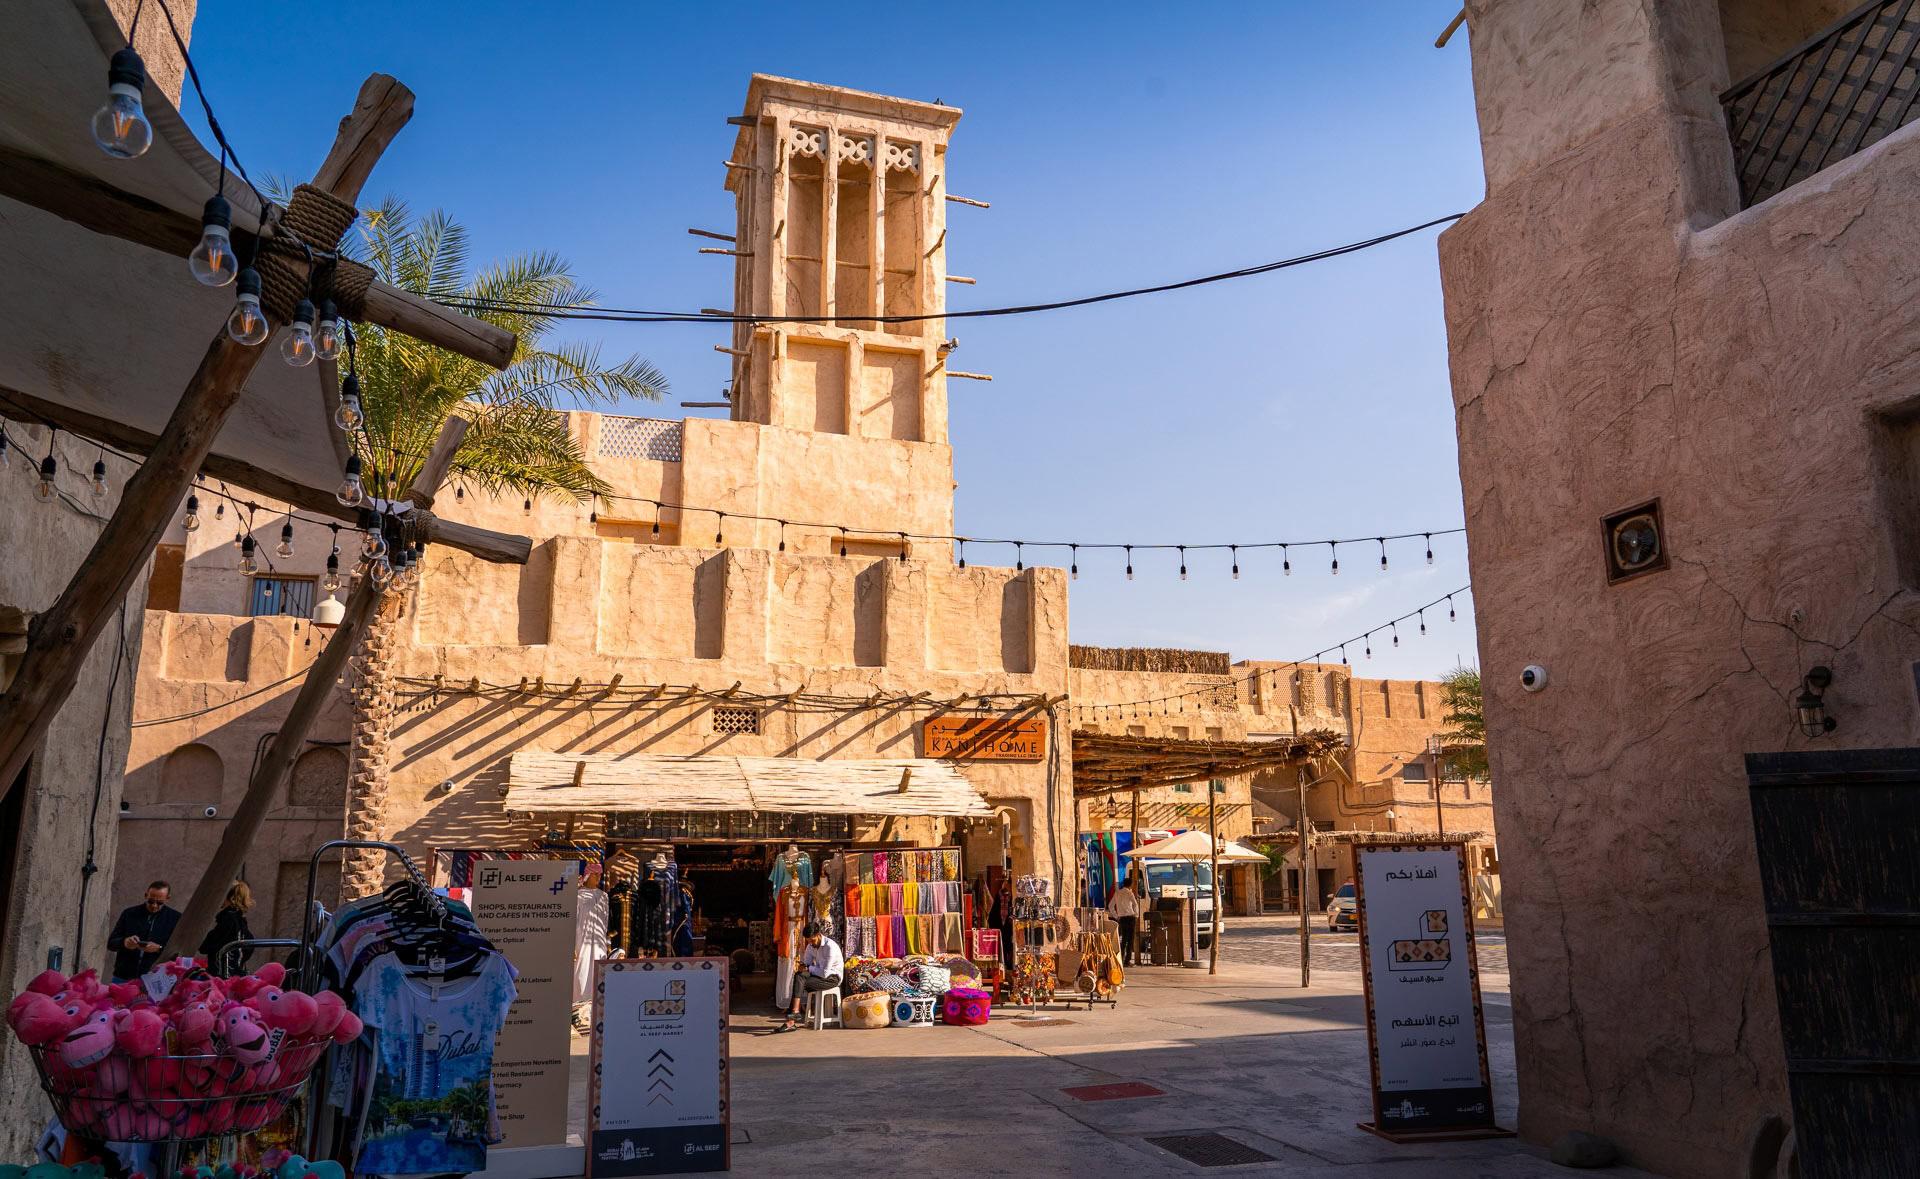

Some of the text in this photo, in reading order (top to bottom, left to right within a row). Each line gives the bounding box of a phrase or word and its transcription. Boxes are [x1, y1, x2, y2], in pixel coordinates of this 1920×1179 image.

[932, 740, 1037, 753] KANI HOME
[504, 874, 542, 882] AL SEEF
[1386, 869, 1413, 881] بكم
[478, 903, 506, 911] SHOPS,
[1399, 975, 1424, 984] السيف
[1391, 1013, 1460, 1029] اتبع الأسهم
[265, 1029, 285, 1061] DUBAI
[426, 1030, 483, 1065] Dubai
